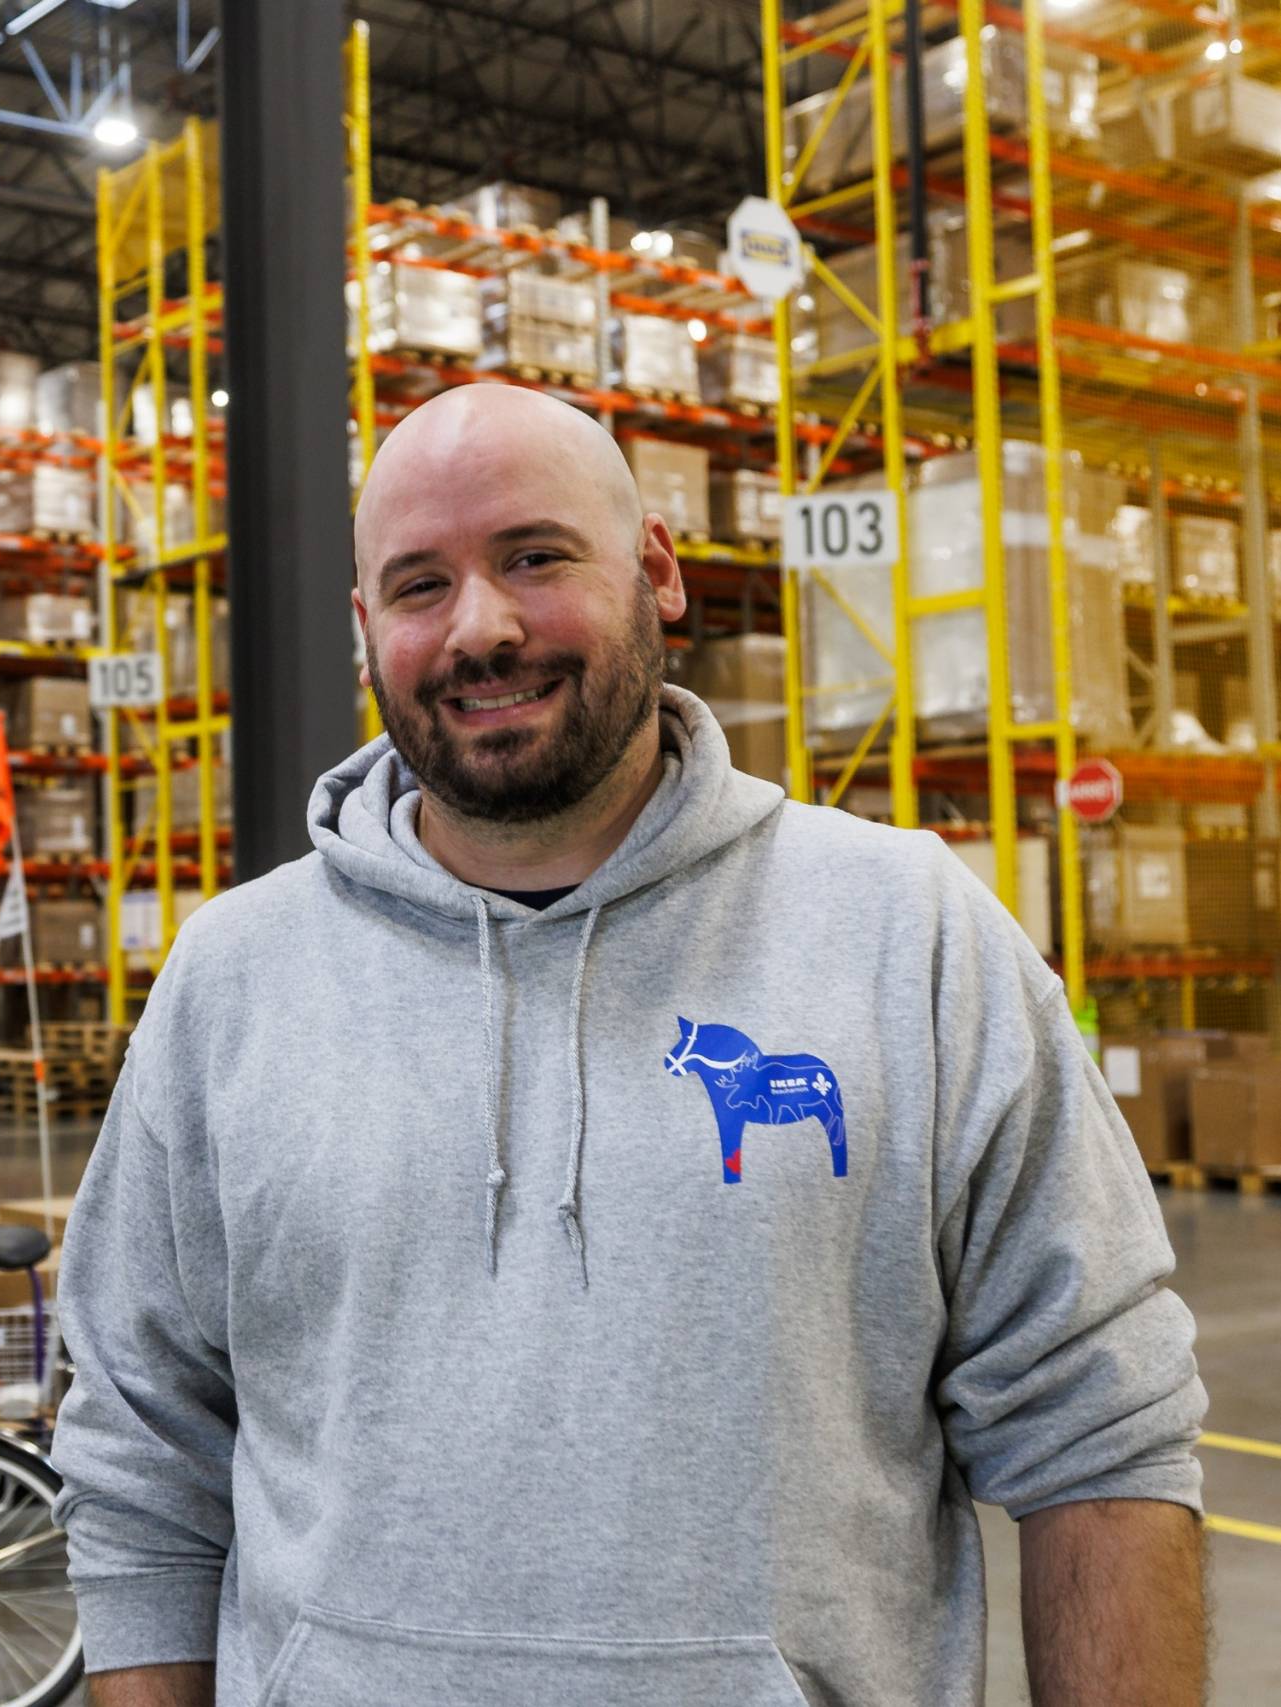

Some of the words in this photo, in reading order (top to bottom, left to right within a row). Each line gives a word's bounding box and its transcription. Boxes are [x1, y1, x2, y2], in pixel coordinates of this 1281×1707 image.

[800, 503, 883, 556] 103
[99, 659, 153, 698] 105
[769, 1077, 808, 1088] IKEA
